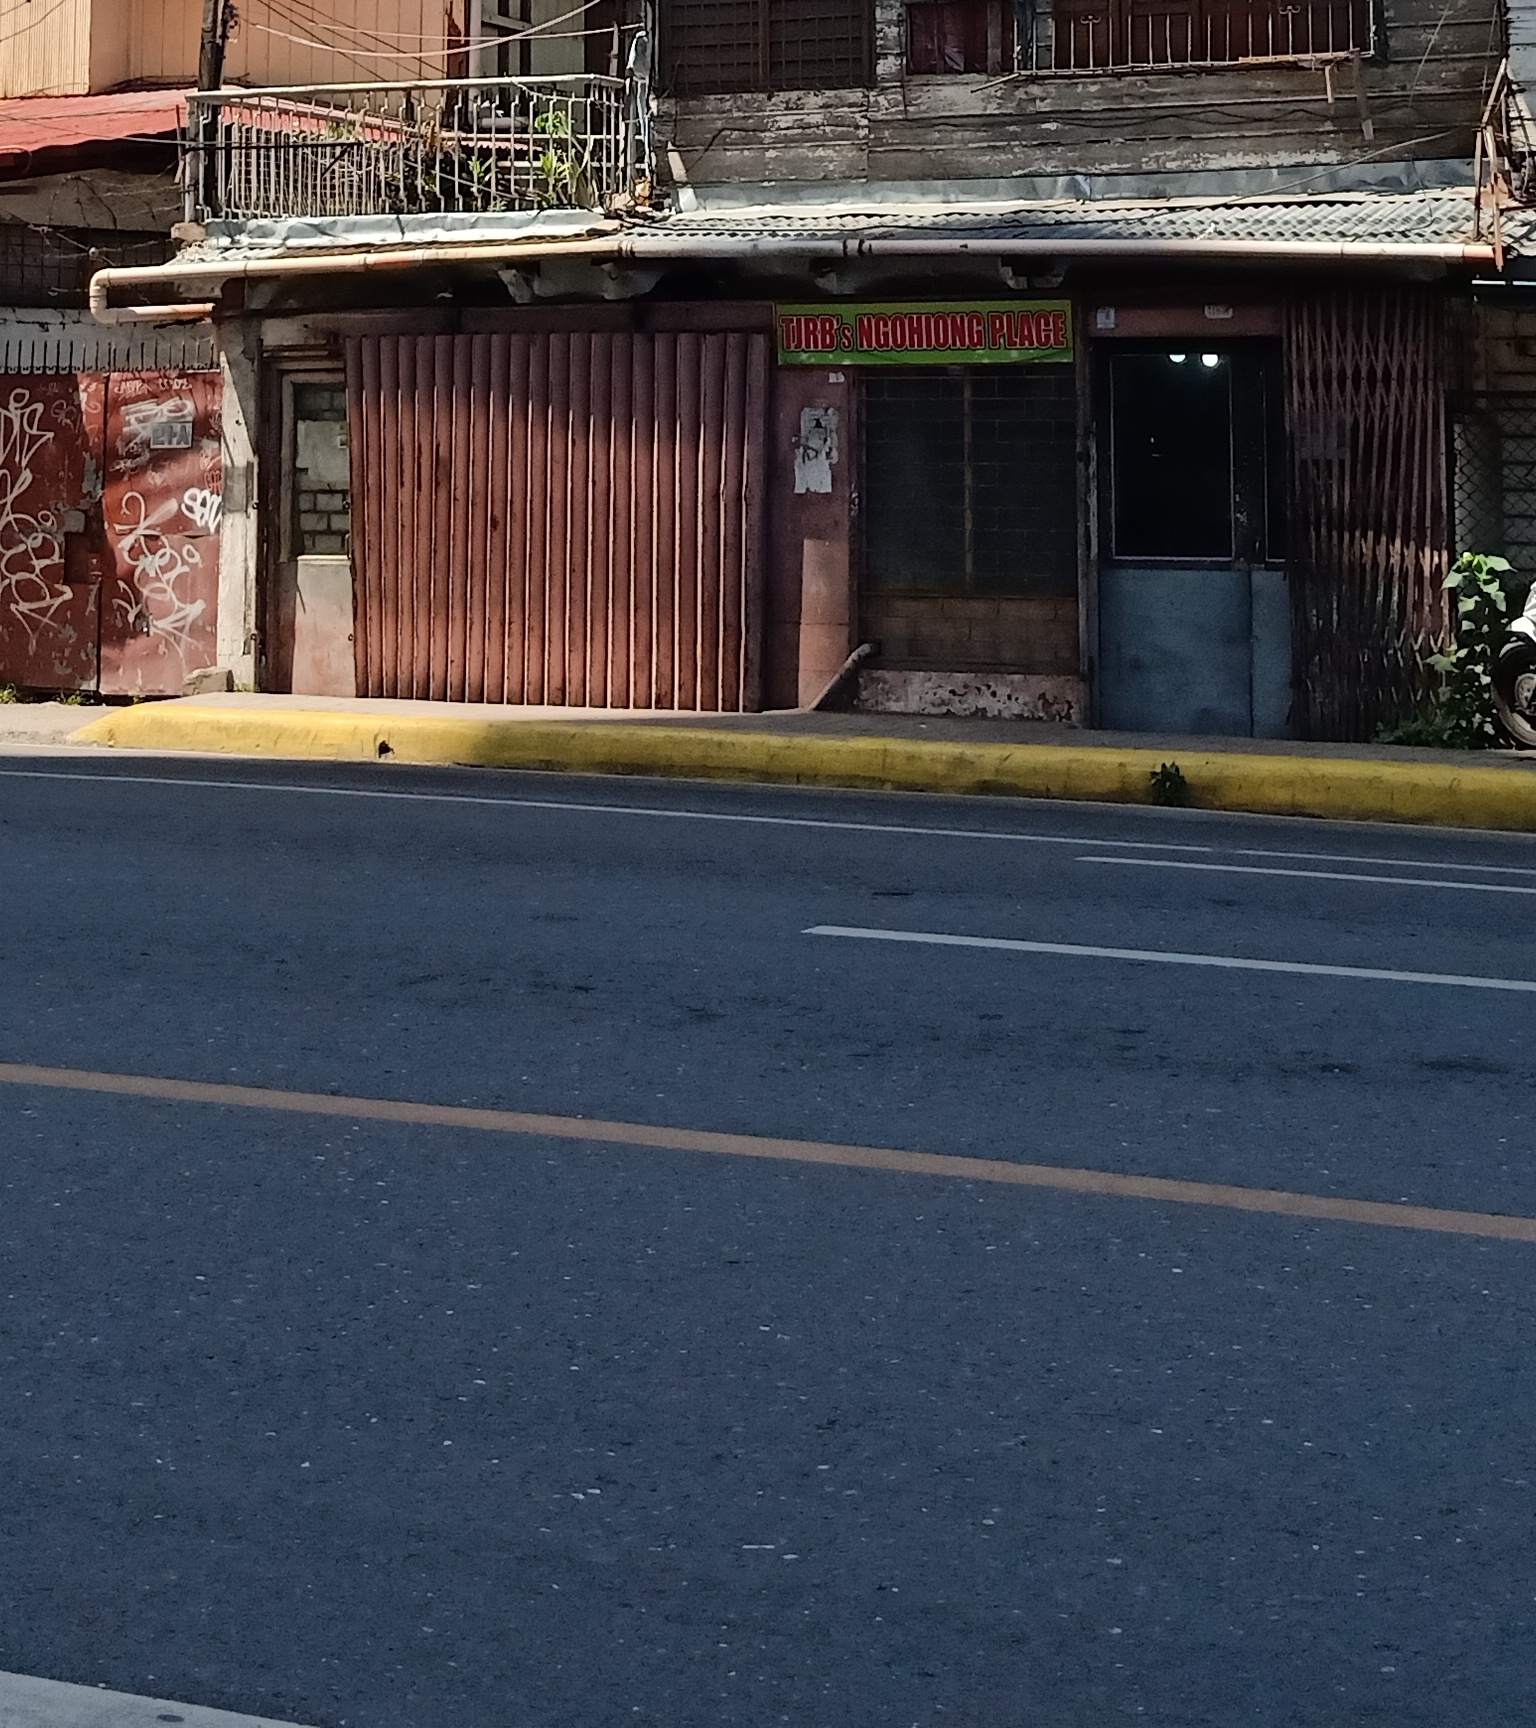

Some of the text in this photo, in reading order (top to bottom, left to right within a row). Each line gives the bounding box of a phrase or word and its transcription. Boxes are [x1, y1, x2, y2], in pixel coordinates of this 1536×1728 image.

[779, 309, 1068, 351] TJRB's NGOHIONG PLACE
